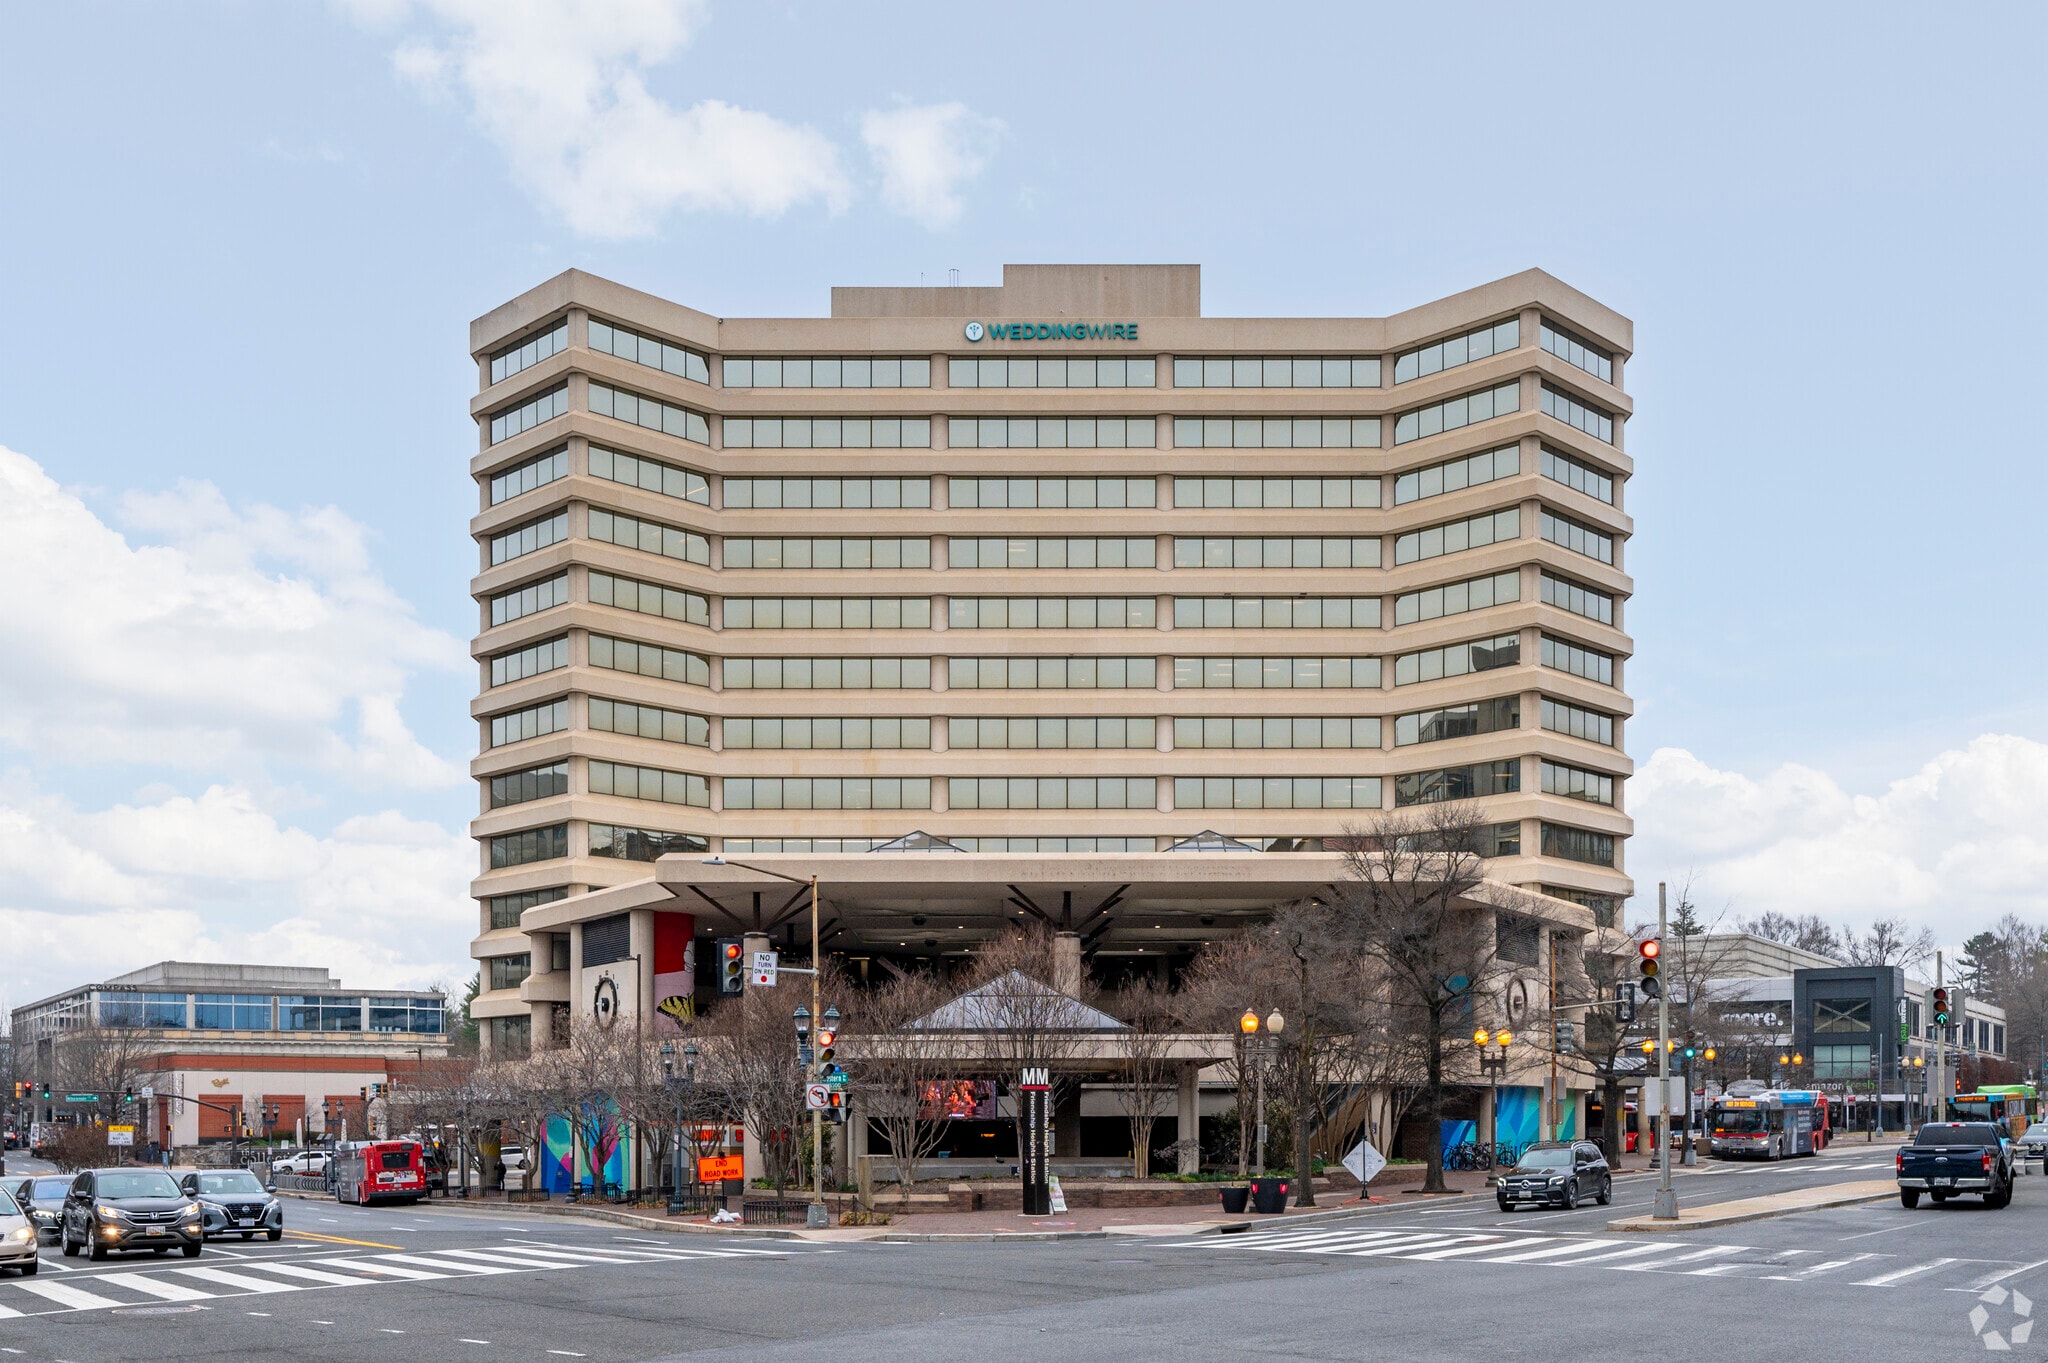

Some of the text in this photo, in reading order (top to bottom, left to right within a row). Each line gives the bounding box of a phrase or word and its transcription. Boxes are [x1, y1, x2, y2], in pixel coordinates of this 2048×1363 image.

[988, 322, 1139, 341] WEDDINGWIRE
[89, 984, 138, 992] COMPASS
[1719, 1012, 1784, 1026] more.
[1023, 1068, 1048, 1085] M M
[1805, 1079, 1875, 1091] amazon fresh
[704, 1169, 739, 1178] ROAD WORK
